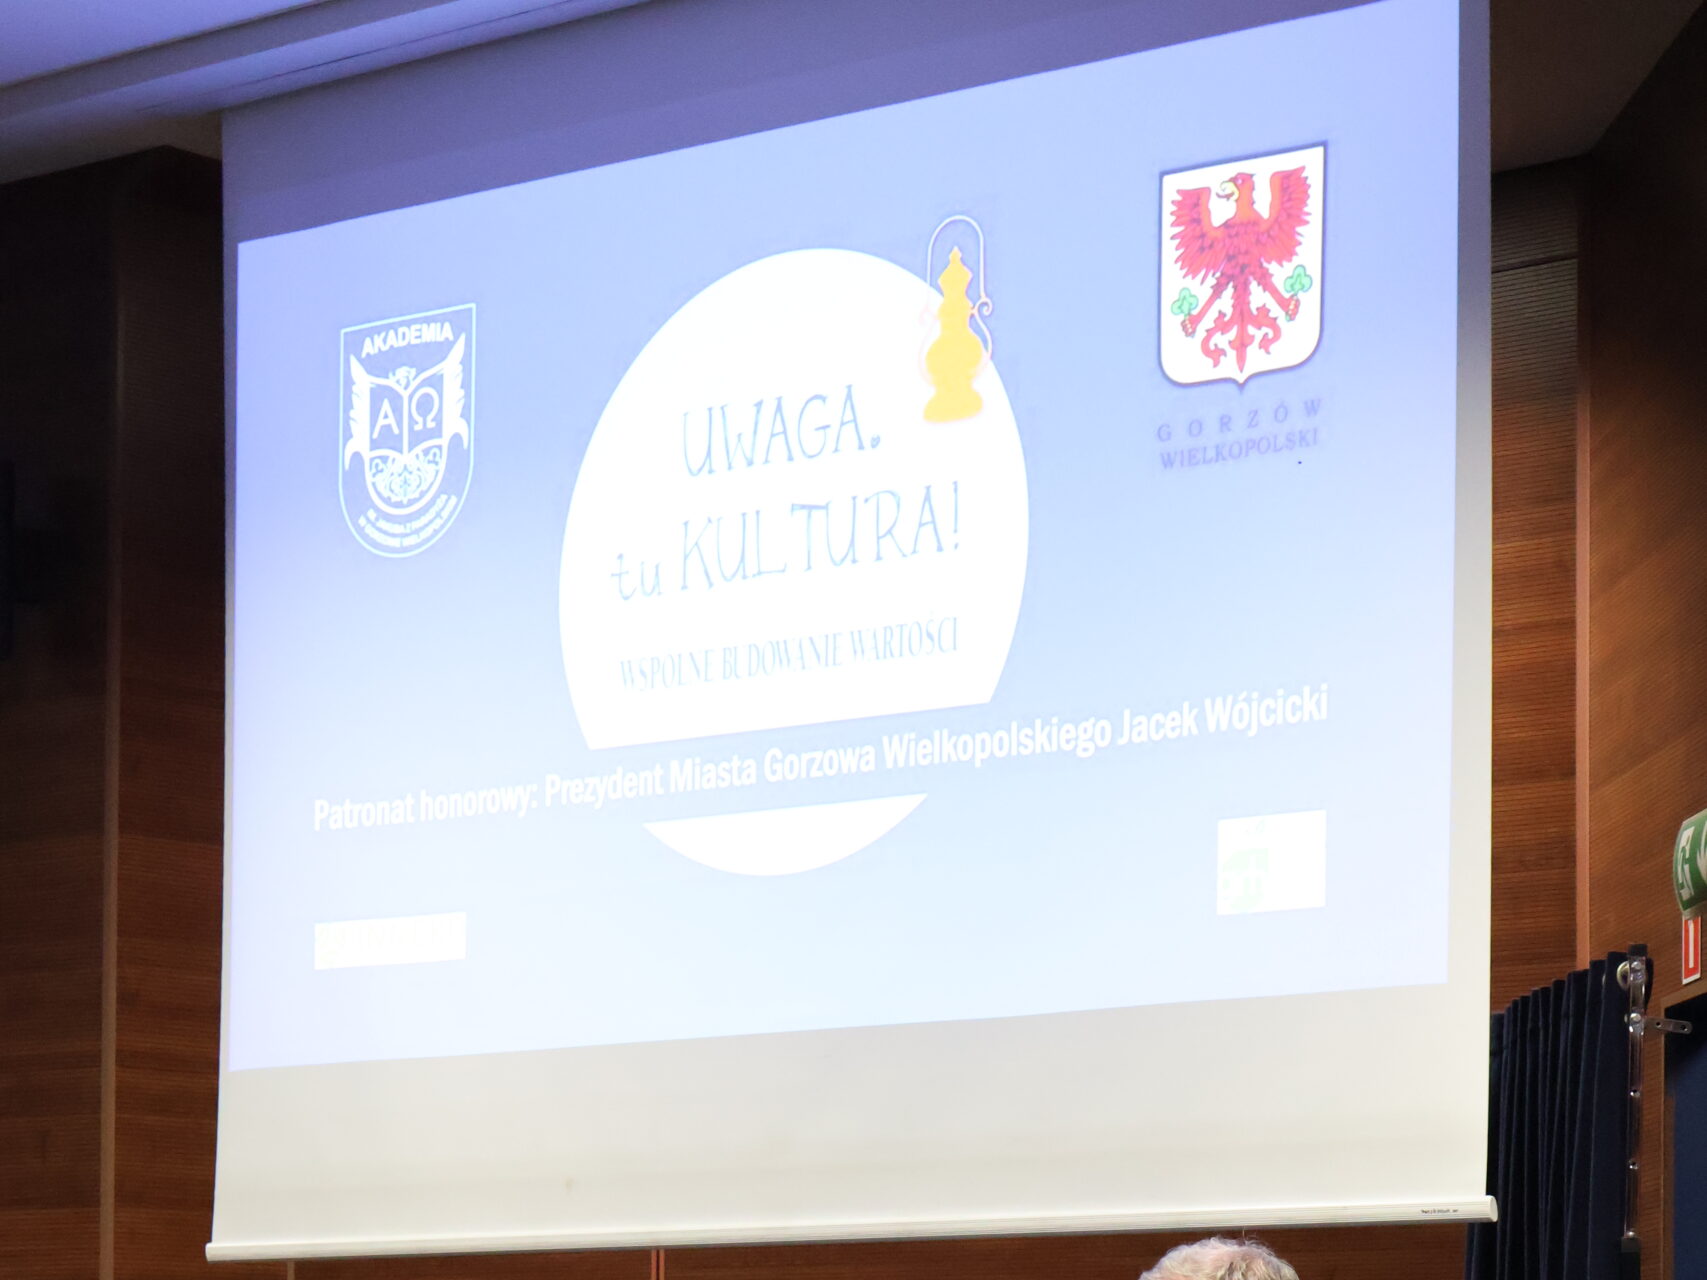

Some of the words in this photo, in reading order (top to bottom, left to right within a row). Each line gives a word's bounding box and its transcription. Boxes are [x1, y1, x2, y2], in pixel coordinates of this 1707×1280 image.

[361, 321, 454, 358] AKADEMIA
[1160, 428, 1320, 471] WIELKOPOLSKI
[610, 552, 663, 602] tu
[681, 481, 960, 594] KULTURA!
[722, 632, 843, 680] BUDOWANIE
[314, 794, 415, 831] Patronat
[420, 783, 538, 819] honorowy:
[545, 764, 663, 809] Prezydent
[670, 753, 757, 793] Miasta
[764, 742, 875, 783] Gorzowa
[883, 716, 1112, 768] Wielkopolskiego
[1117, 701, 1200, 746] Jacek
[1205, 683, 1329, 738] Wójcicki
